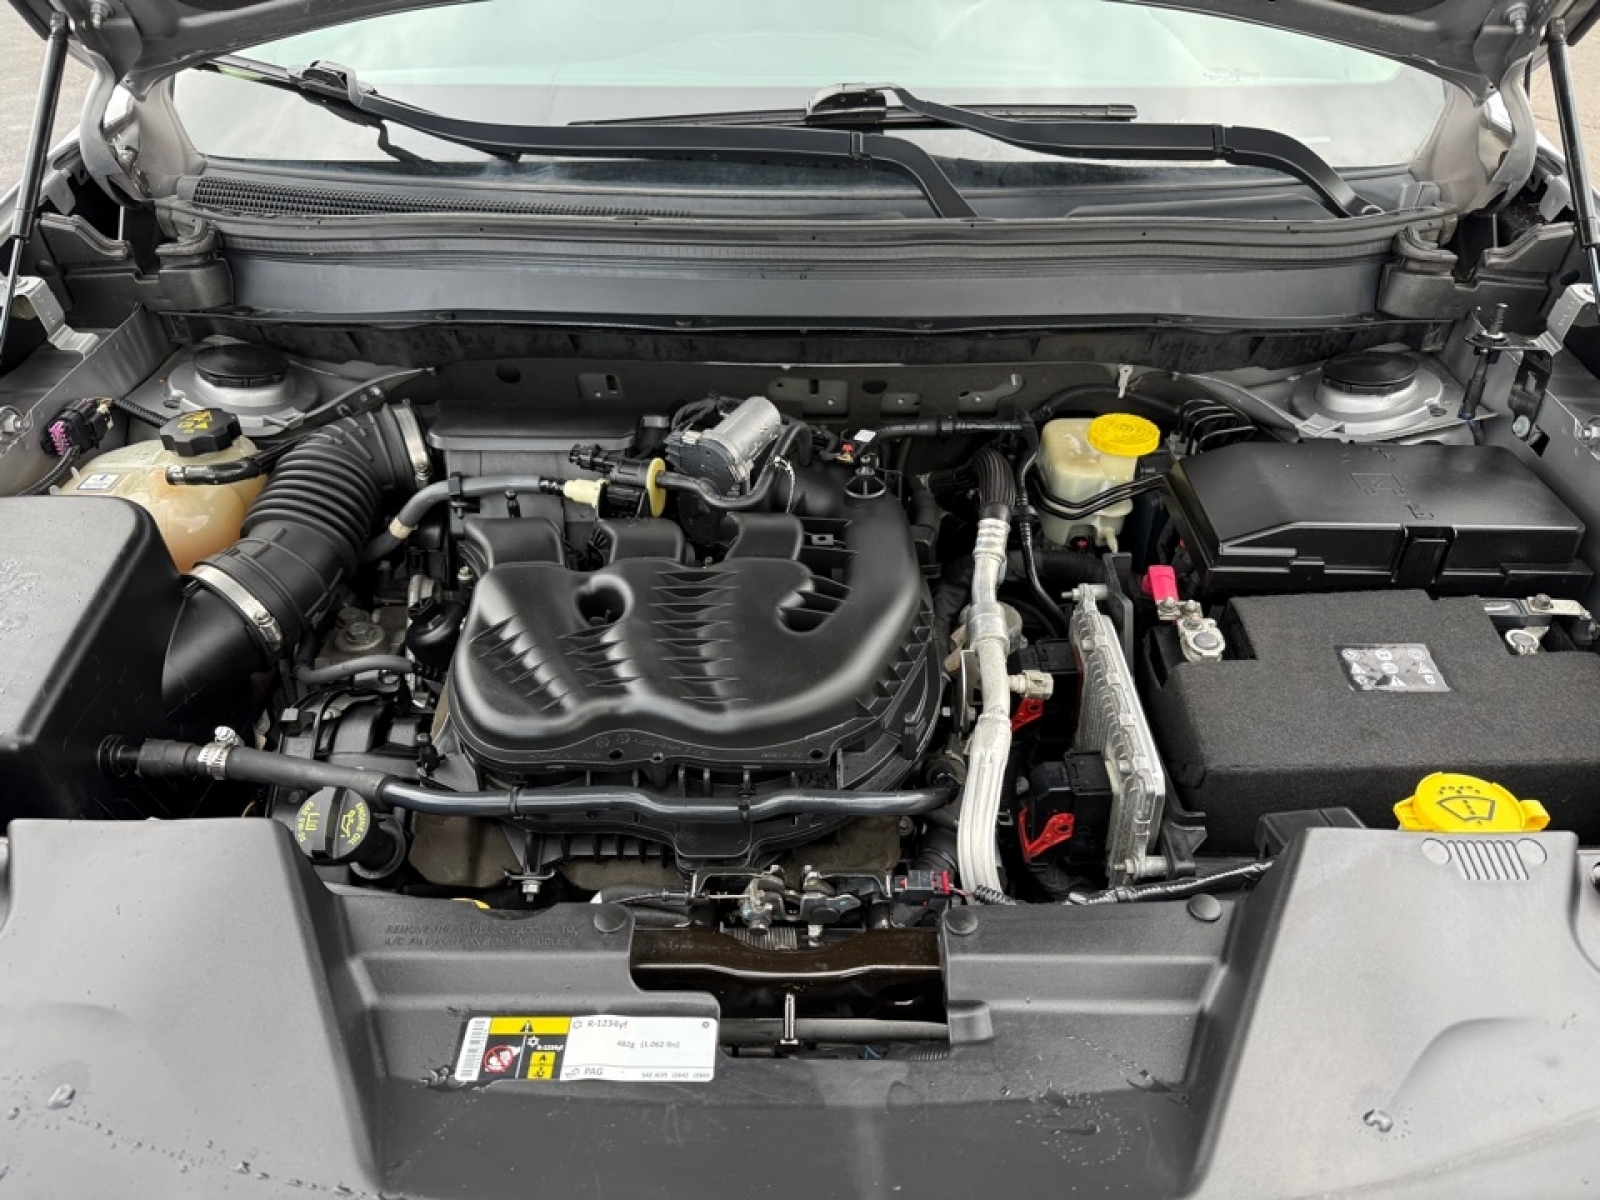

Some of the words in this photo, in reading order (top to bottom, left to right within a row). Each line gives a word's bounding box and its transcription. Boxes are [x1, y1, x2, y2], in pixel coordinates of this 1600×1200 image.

[355, 802, 366, 832] ENGINE
[347, 833, 361, 846] OIL
[587, 1019, 628, 1030] R-1234yf
[640, 1040, 664, 1049] (1.062
[666, 1040, 680, 1049] lbs)
[584, 1067, 604, 1076] PAG
